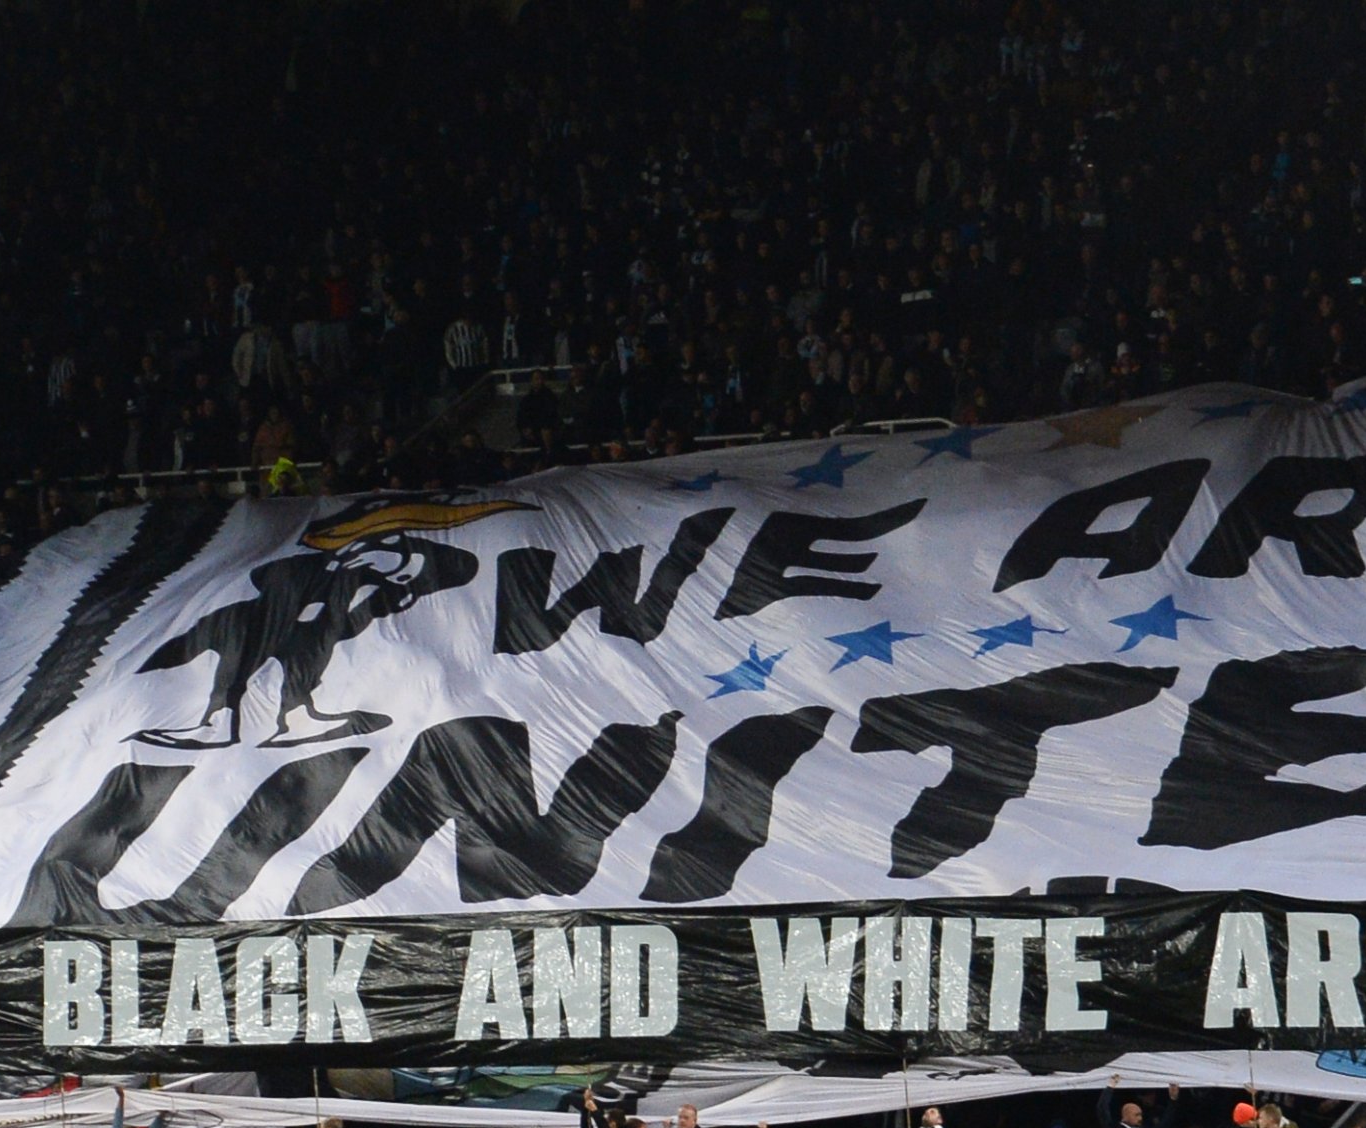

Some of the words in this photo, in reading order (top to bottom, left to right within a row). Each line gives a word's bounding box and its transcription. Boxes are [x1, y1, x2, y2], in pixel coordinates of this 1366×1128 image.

[493, 496, 926, 654] WE
[42, 933, 373, 1046] BLACK
[454, 924, 678, 1040] AND
[749, 914, 1107, 1032] WHITE
